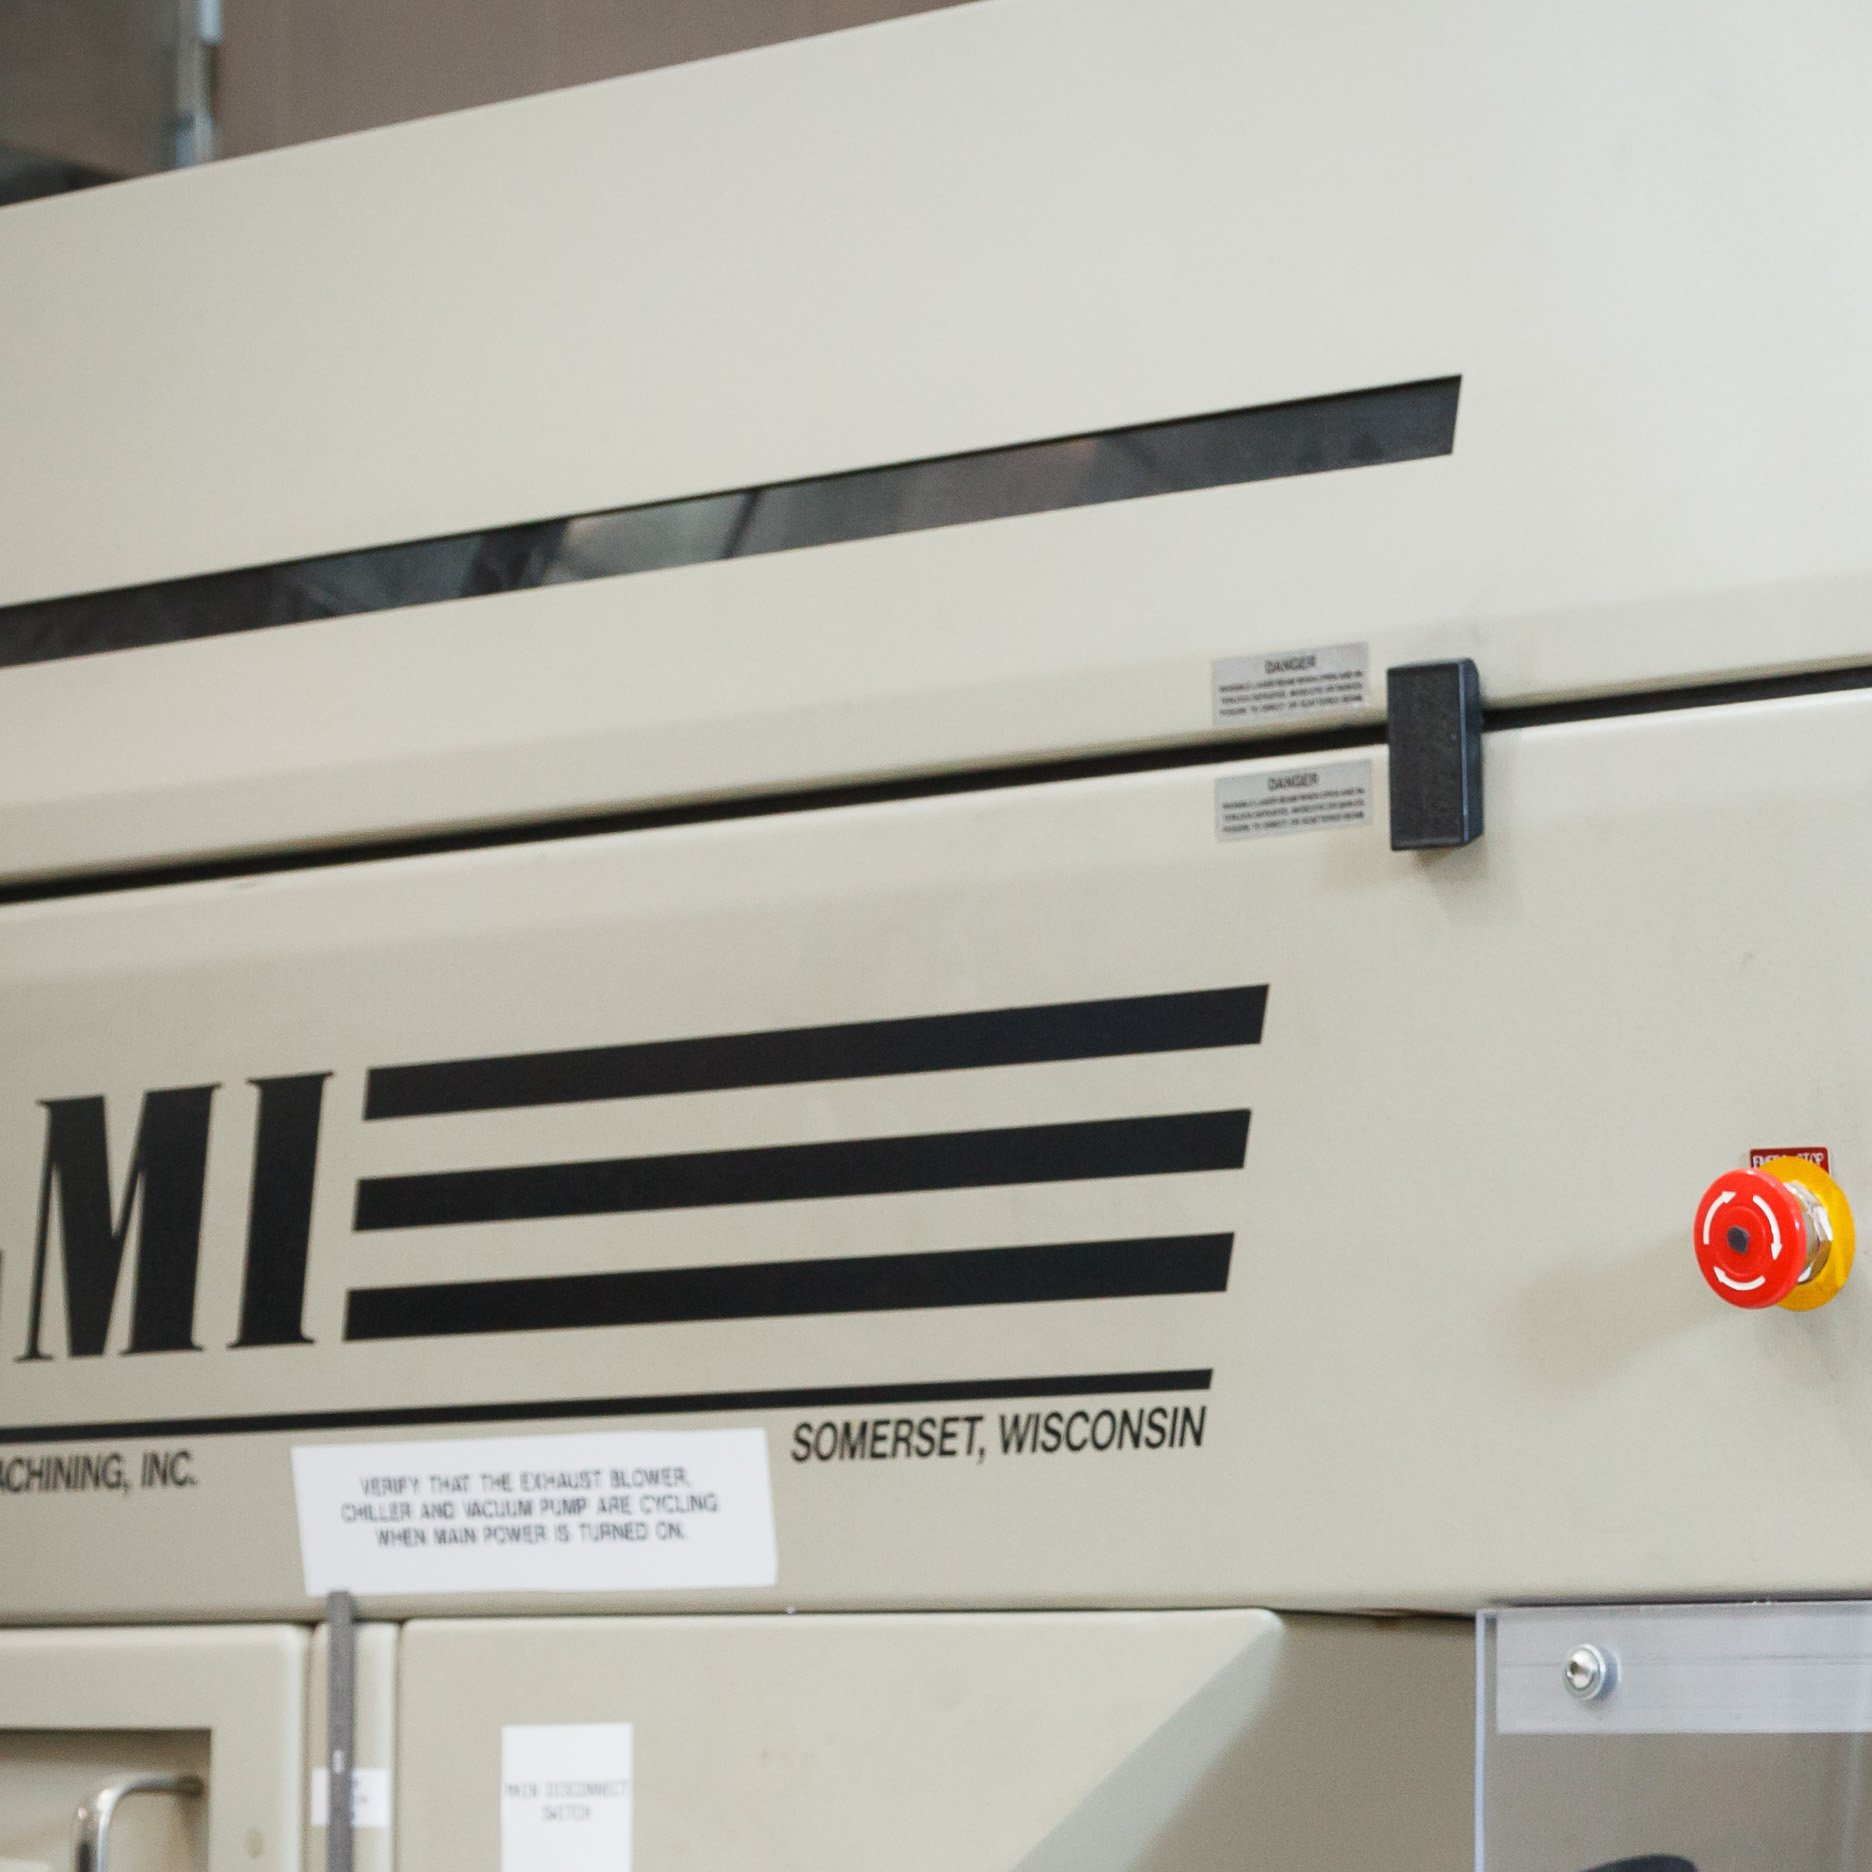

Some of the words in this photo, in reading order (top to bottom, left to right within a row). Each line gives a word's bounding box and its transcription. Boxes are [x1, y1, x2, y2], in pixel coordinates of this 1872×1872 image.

[0, 1071, 335, 1364] MI
[791, 1415, 985, 1466] SOMERSET,
[998, 1406, 1207, 1455] WISCONSIN
[141, 1449, 198, 1488] INC.
[360, 1476, 419, 1497] VERIFY
[430, 1474, 470, 1495] THAT
[479, 1473, 513, 1493] THE
[519, 1470, 601, 1492] EXHAUST
[610, 1466, 691, 1488] BLOWER,
[341, 1502, 411, 1523] CHILLER
[420, 1502, 455, 1521] AND
[464, 1499, 532, 1520] VACUUM
[540, 1498, 586, 1517] PUMP
[597, 1496, 631, 1515] ARE
[640, 1493, 719, 1514] CYCLING
[375, 1527, 426, 1548] WHEN
[434, 1527, 476, 1546] MAIN
[483, 1525, 545, 1545] POWER
[554, 1523, 569, 1543] IS
[580, 1522, 648, 1543] TURNED
